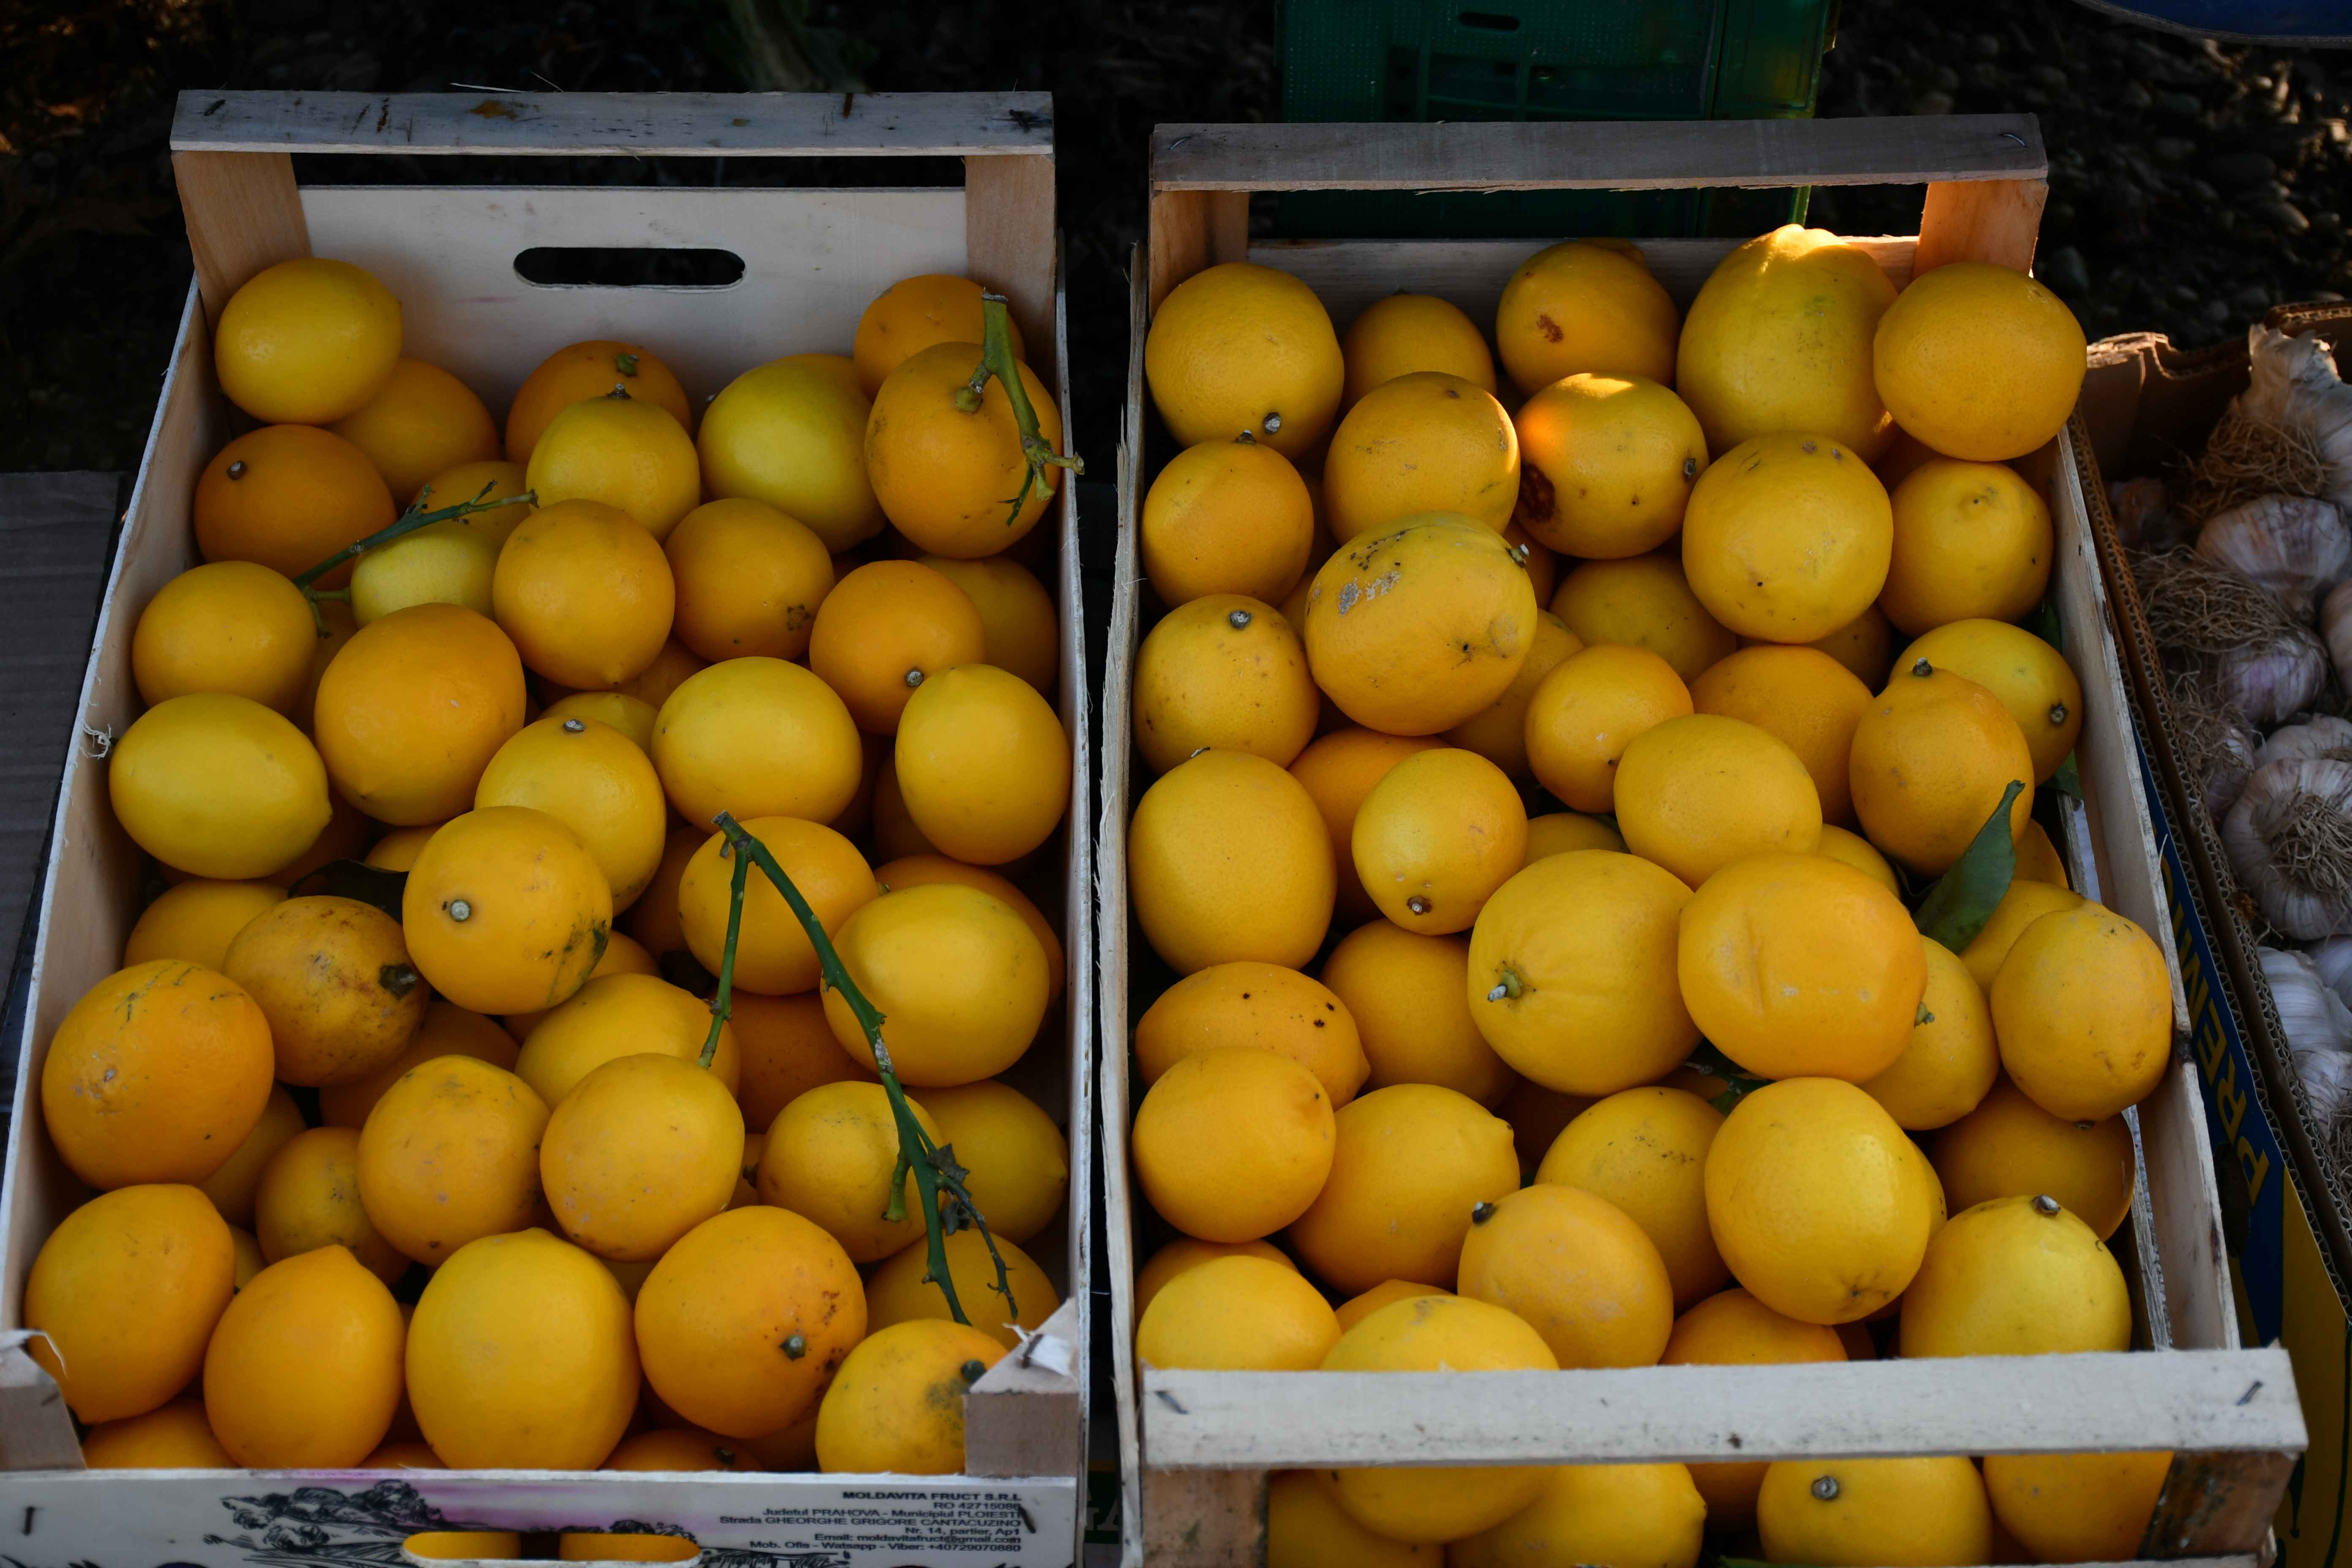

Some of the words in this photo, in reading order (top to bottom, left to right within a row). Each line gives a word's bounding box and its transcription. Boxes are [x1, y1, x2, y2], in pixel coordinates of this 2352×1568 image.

[2151, 819, 2270, 1207] PREMI
[843, 1492, 927, 1500] MOLDAVITA
[891, 1510, 953, 1518] Municipiul
[921, 1519, 1021, 1527] CANTACUZINO
[857, 1535, 1021, 1544] moldavitafruct@gmail.com
[821, 1542, 876, 1551] Watsapp
